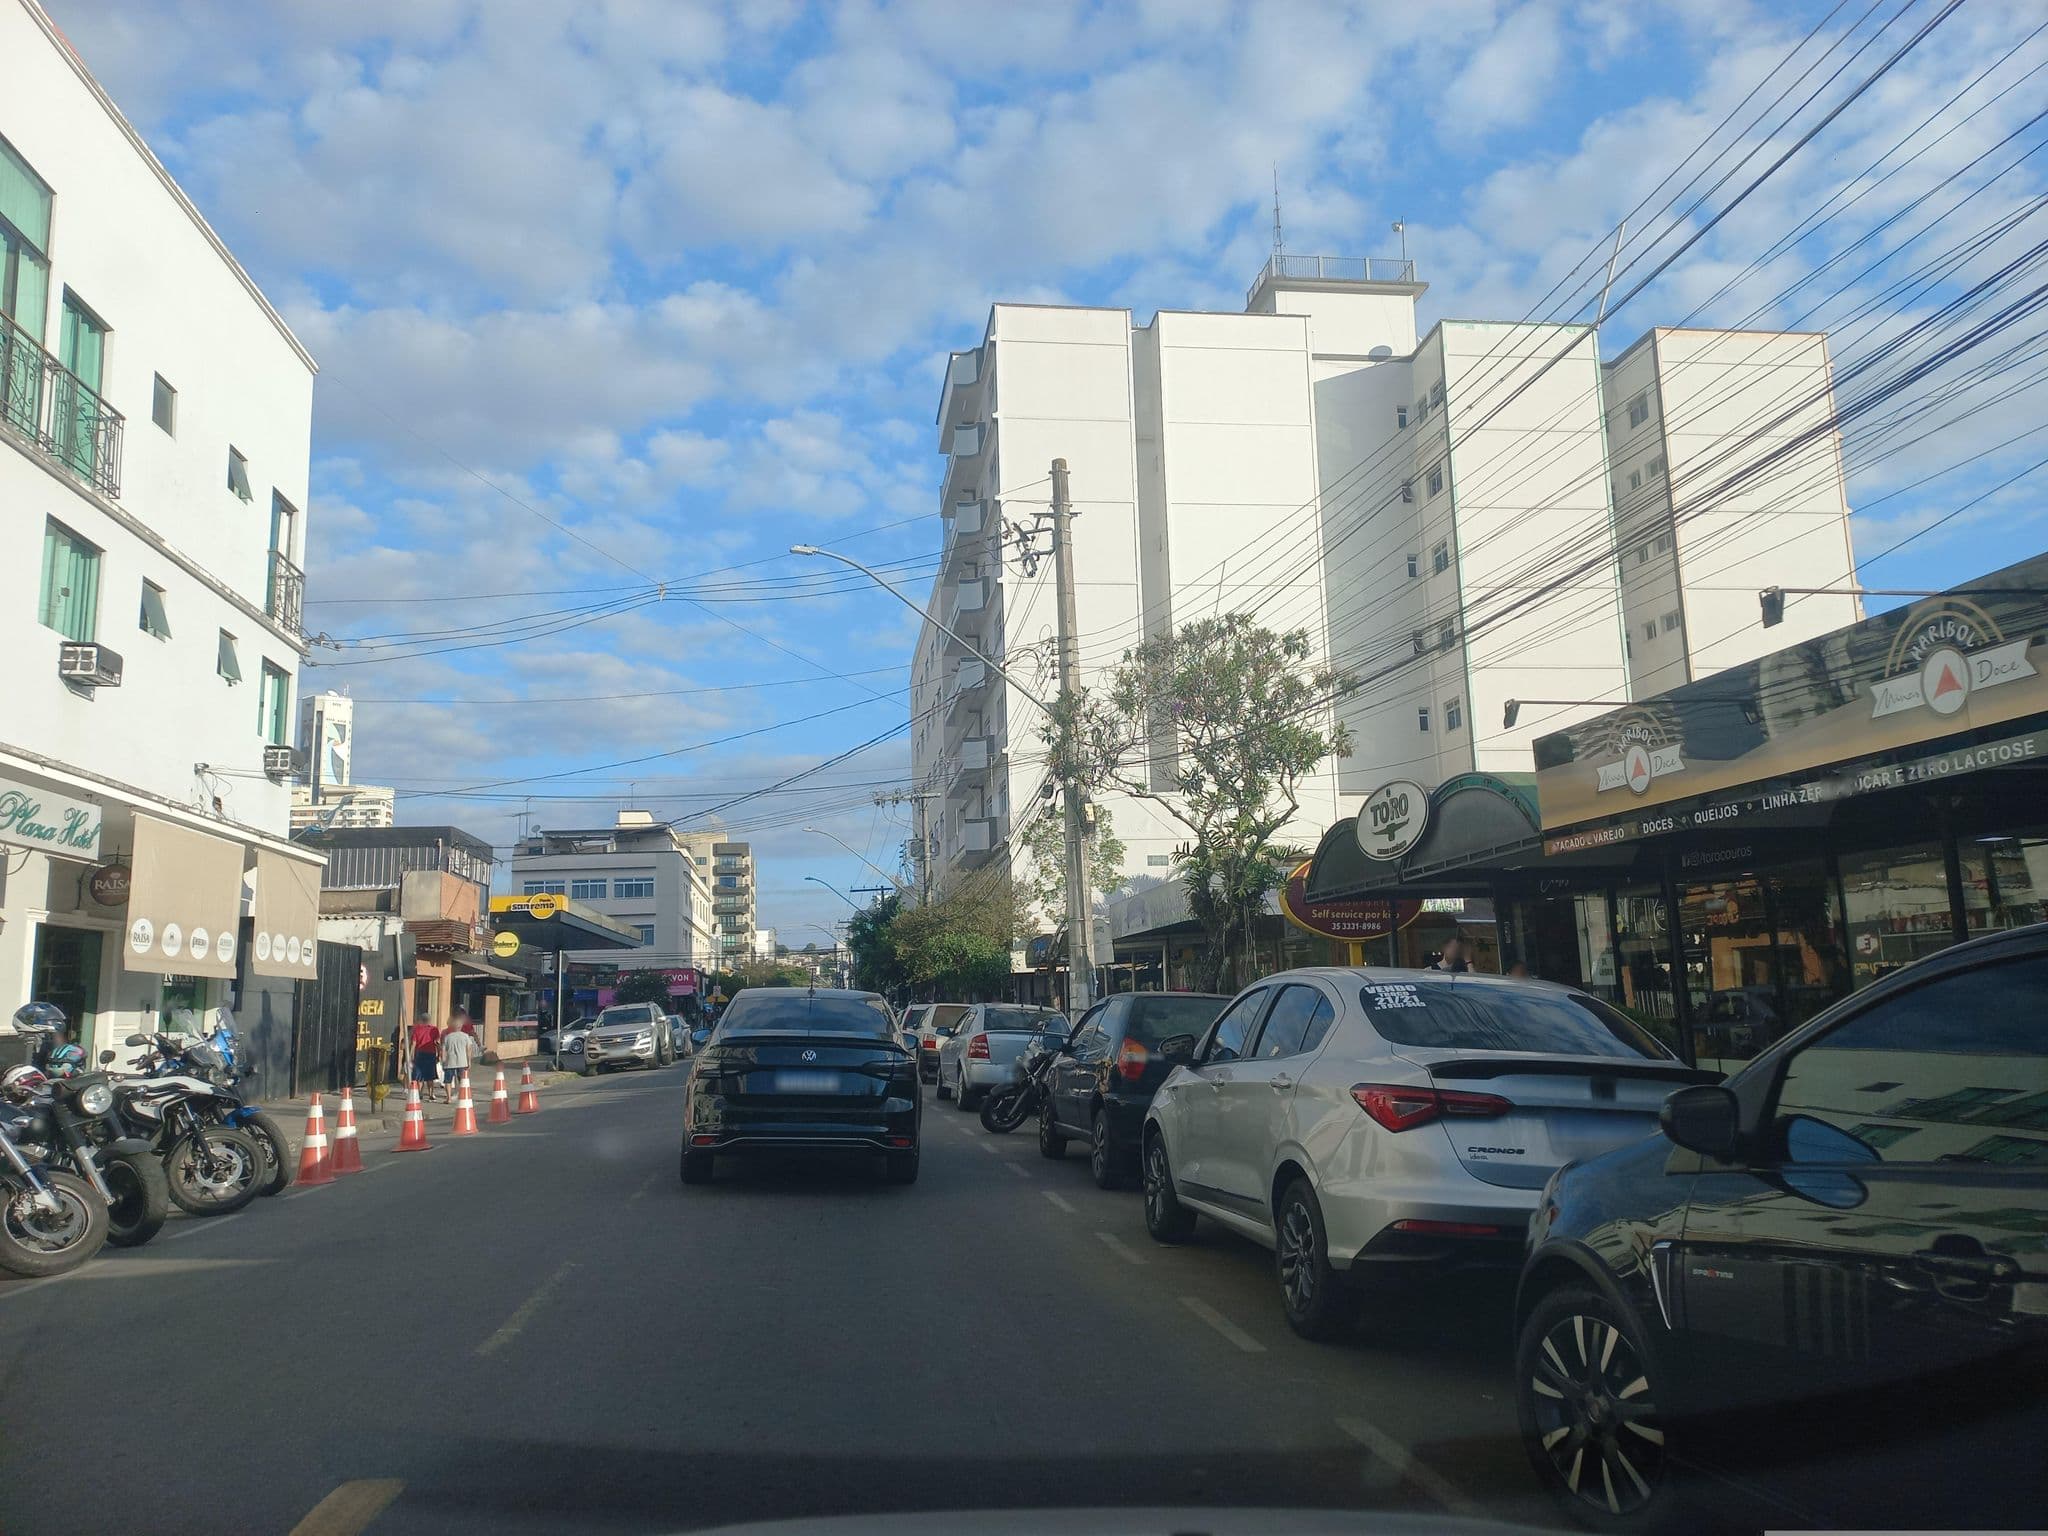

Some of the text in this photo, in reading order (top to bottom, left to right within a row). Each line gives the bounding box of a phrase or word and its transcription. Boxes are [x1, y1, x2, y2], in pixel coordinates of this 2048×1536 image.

[1910, 620, 1974, 661] MARIBOL
[1976, 659, 2019, 683] Doce
[1553, 836, 1585, 851] TACADO
[1592, 827, 1625, 844] VAREJO
[1642, 817, 1674, 834] DOCES
[1694, 804, 1739, 824] QUEIJOS
[1762, 792, 1798, 810] LINHA
[1799, 785, 1826, 804] ZER
[1953, 739, 2037, 771] LACTOSE
[1369, 792, 1409, 828] TORO
[1311, 909, 1328, 919] Self
[1364, 911, 1380, 921] por
[1331, 922, 1341, 930] 35
[1364, 984, 1417, 994] VENDO
[1467, 1146, 1525, 1155] CRONOS
